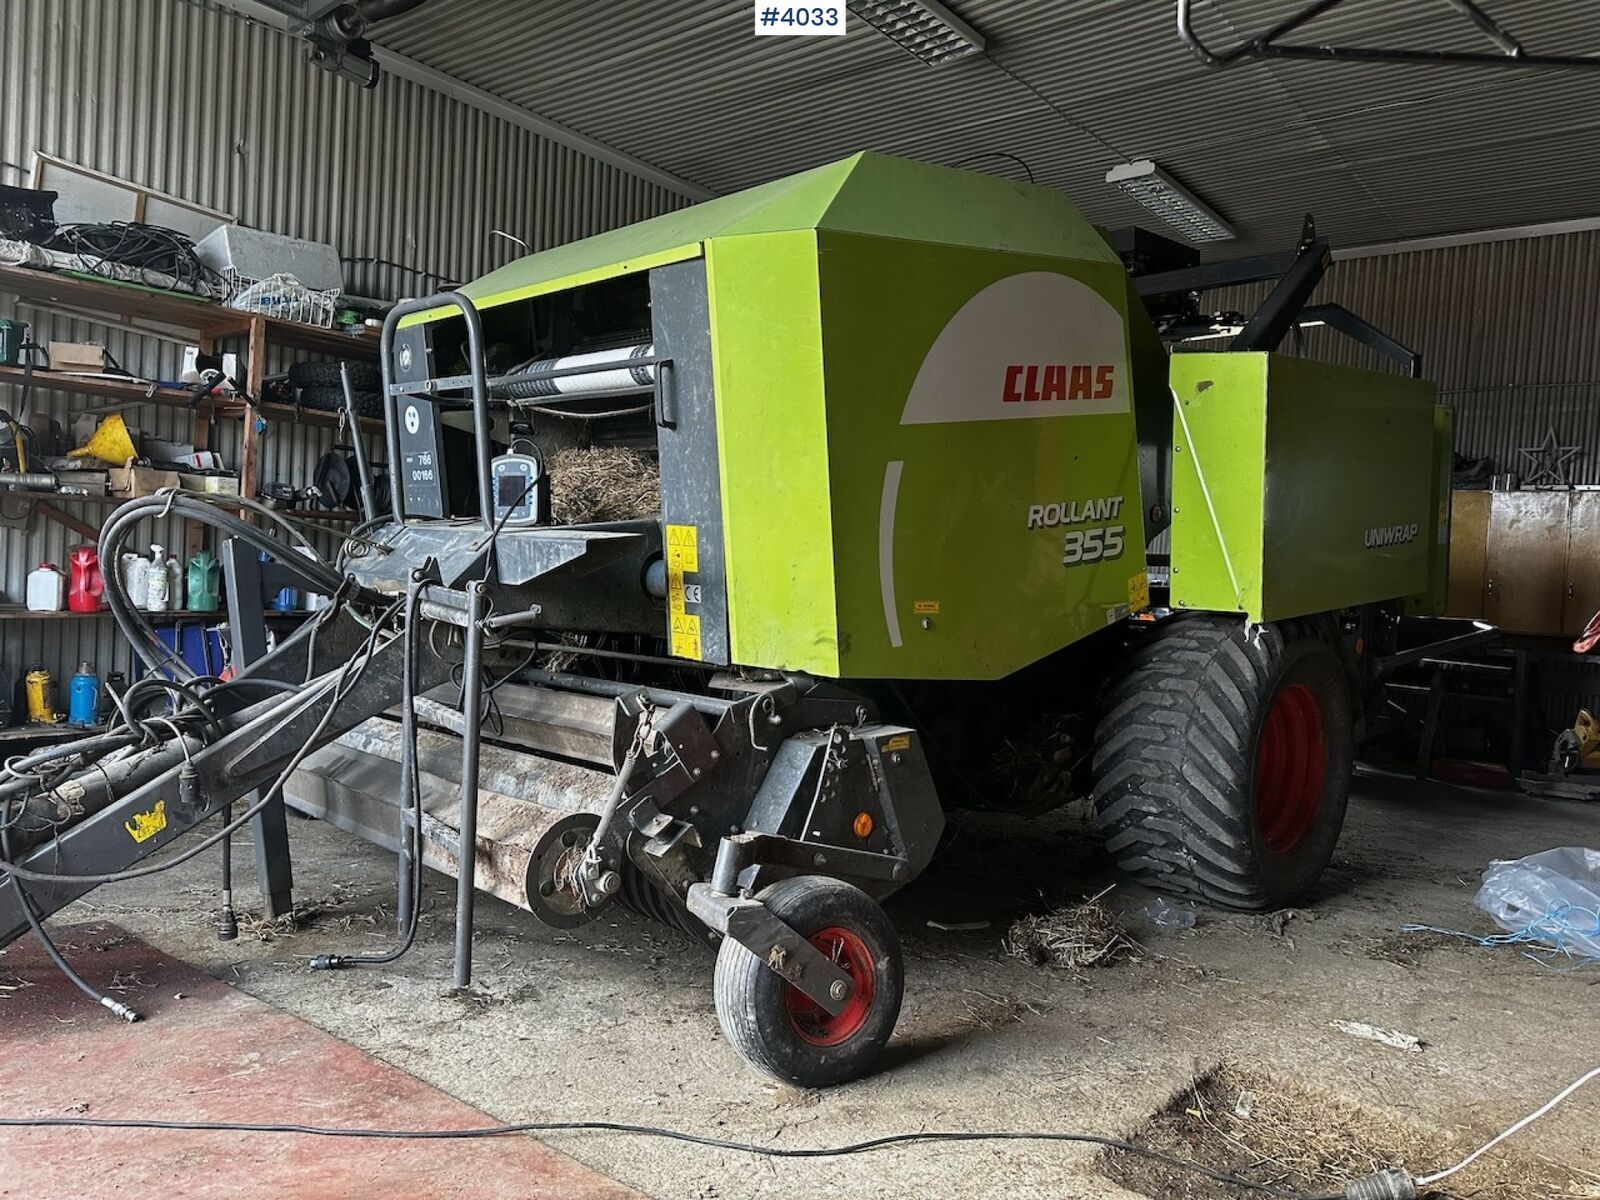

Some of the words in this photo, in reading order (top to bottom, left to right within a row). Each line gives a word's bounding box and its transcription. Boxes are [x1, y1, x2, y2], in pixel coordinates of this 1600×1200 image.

[1002, 365, 1114, 402] CLAAS
[1027, 496, 1124, 530] ROLLANT
[1062, 525, 1124, 567] 355
[1364, 523, 1418, 548] UNIWRAP
